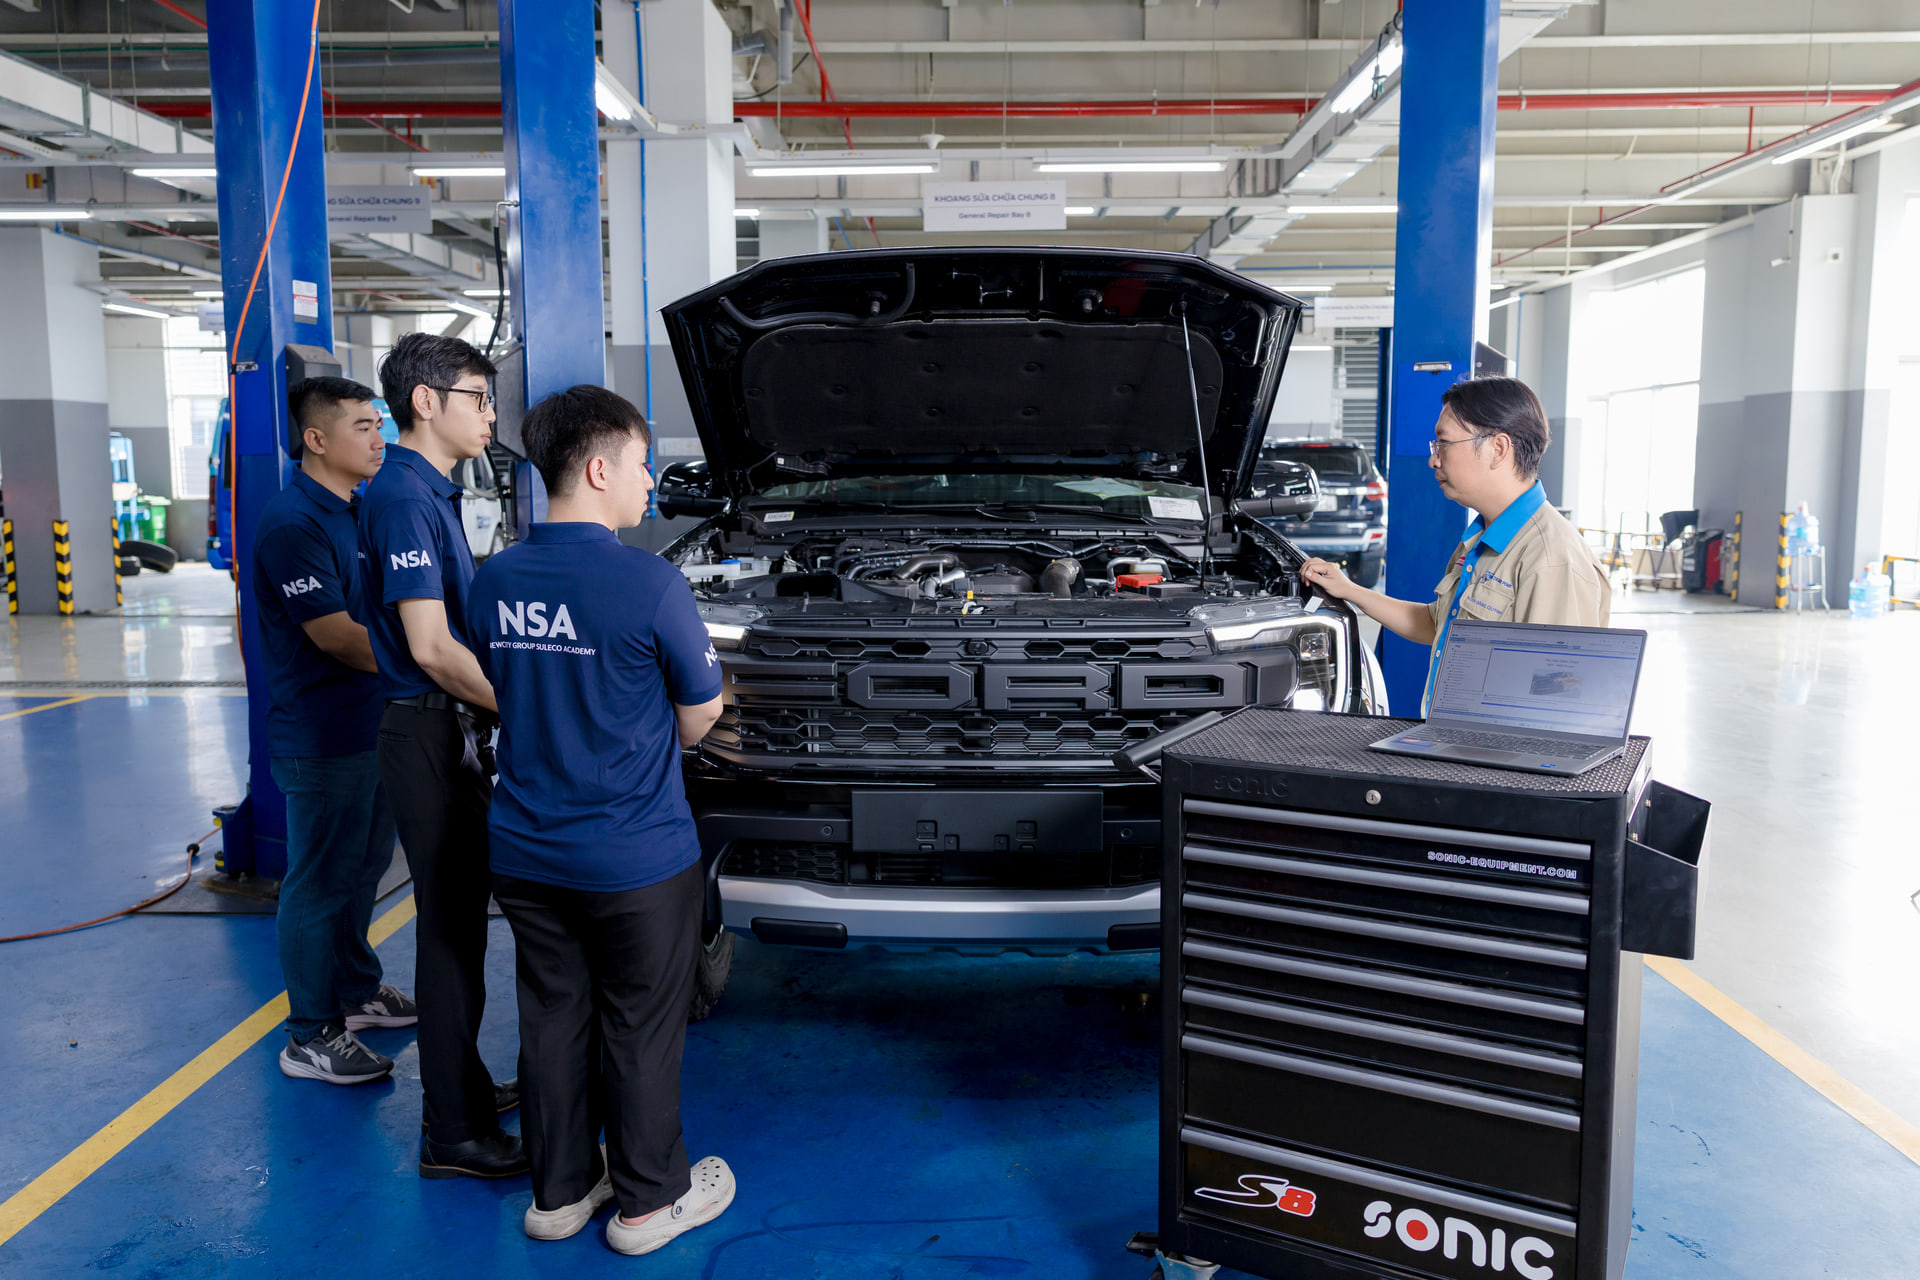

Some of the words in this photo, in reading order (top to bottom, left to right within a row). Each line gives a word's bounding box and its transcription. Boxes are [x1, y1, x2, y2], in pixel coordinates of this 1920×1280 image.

[383, 197, 413, 205] CHUNG
[934, 195, 971, 203] KHOANG
[1017, 193, 1049, 201] CHUNG
[390, 549, 432, 571] NSA
[282, 575, 323, 598] NSA
[497, 599, 578, 640] NSA
[512, 641, 536, 650] GROUP
[536, 643, 563, 652] SULECO
[563, 645, 597, 656] ACADEMY
[1427, 850, 1578, 880] SONIC-EQUIPMENT.COM
[1194, 1173, 1318, 1218] S8
